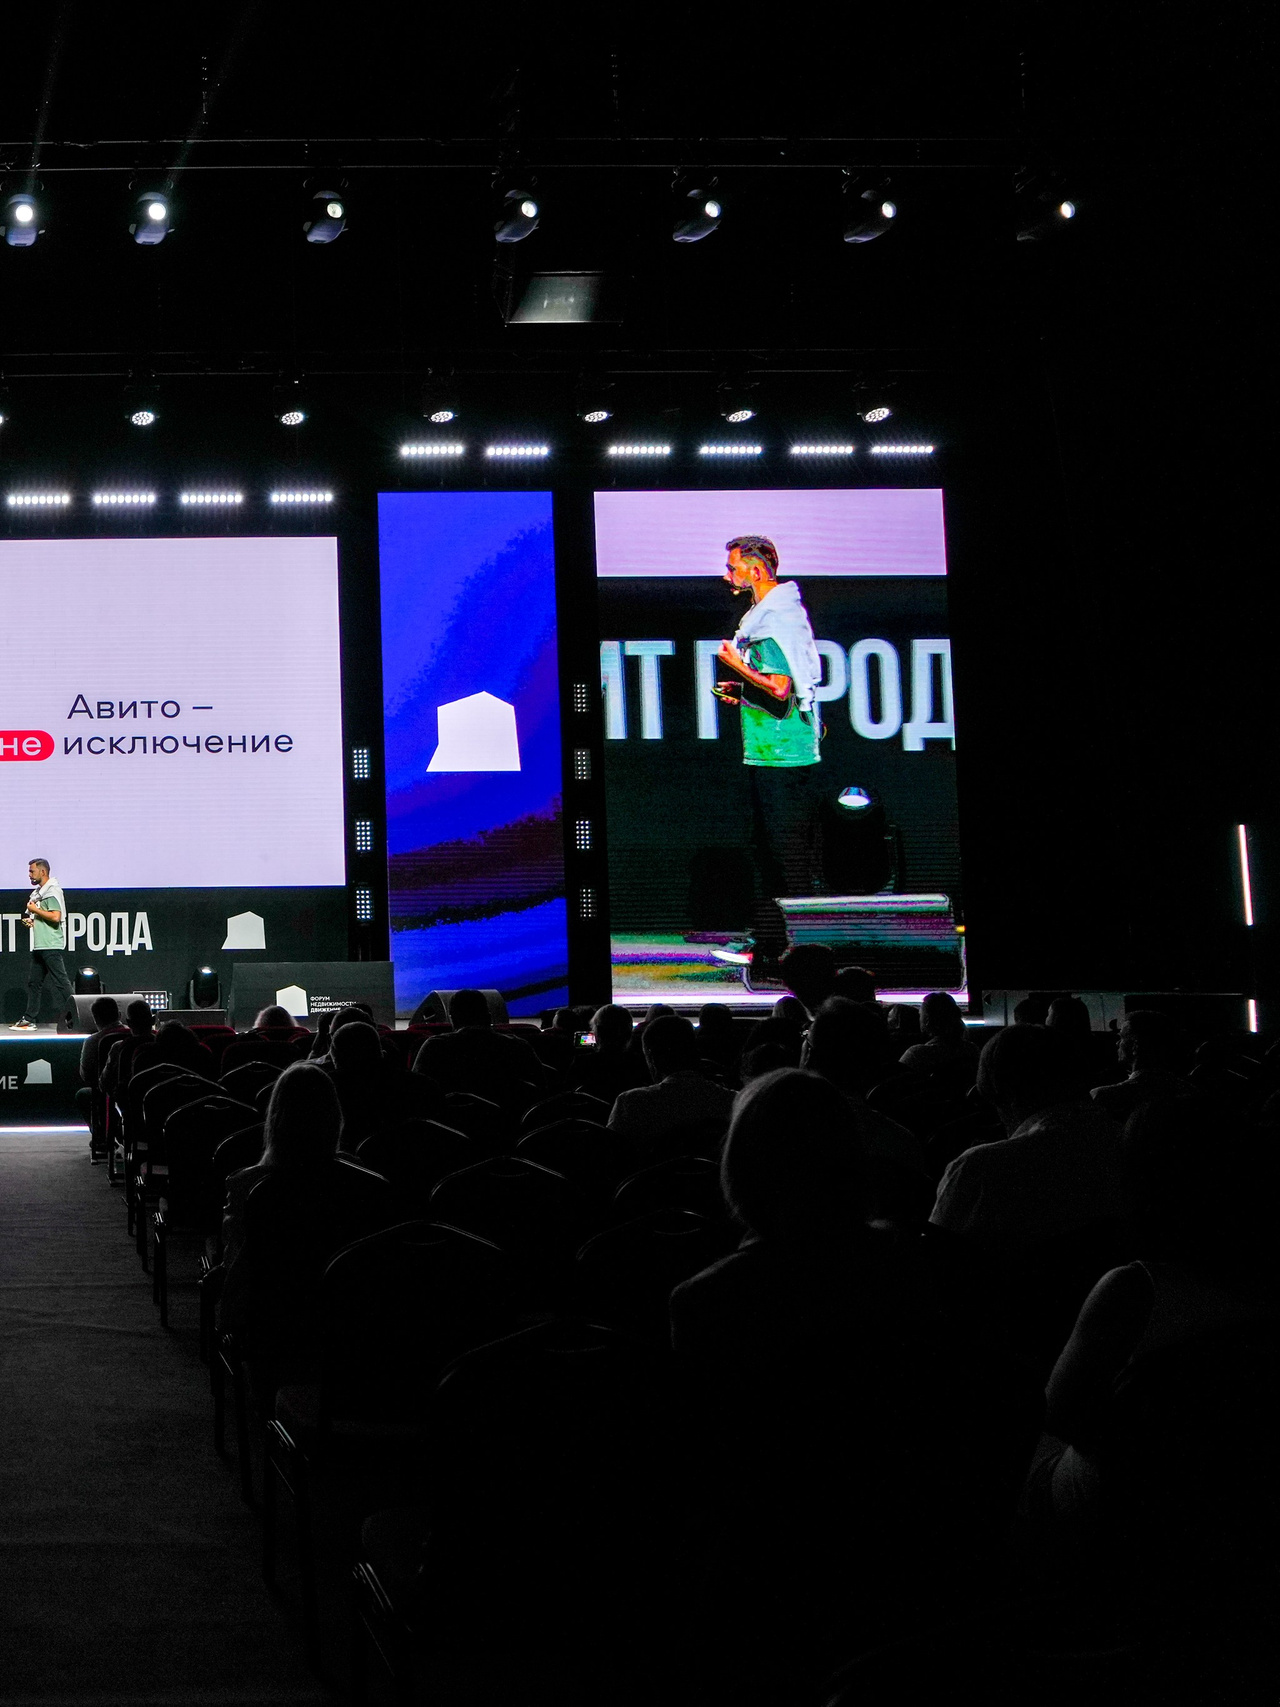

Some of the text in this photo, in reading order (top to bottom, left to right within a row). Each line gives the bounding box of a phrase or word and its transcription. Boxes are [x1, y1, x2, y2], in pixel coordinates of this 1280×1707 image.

[67, 694, 181, 719] Авито
[694, 638, 956, 751] ГРОД
[63, 734, 294, 755] исключение
[29, 911, 153, 956] РОДА
